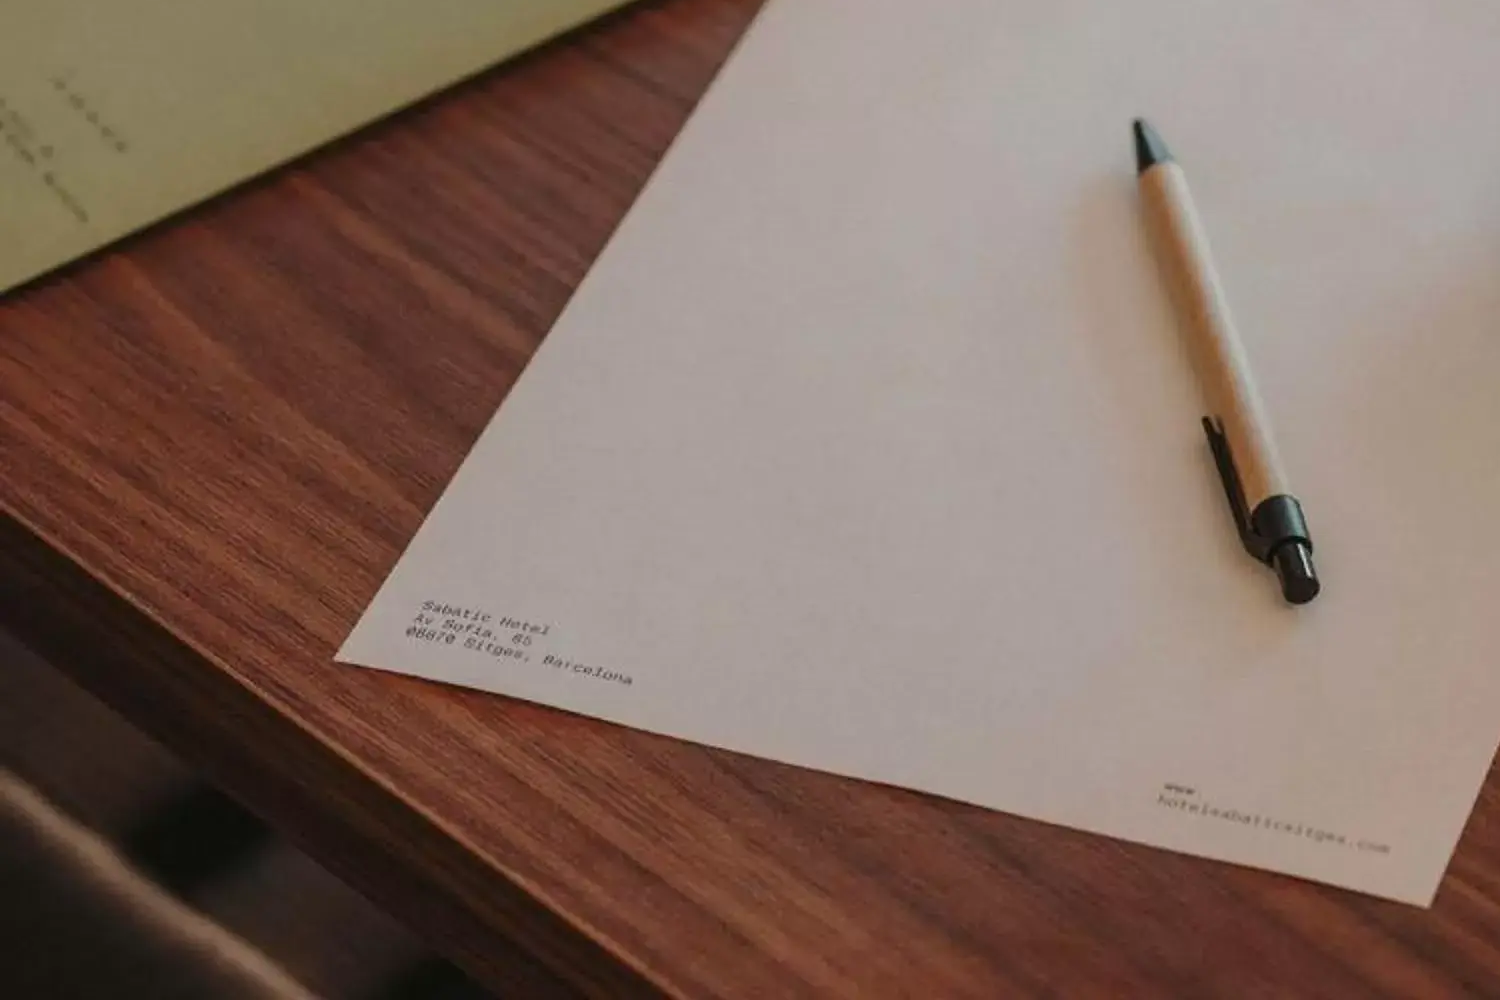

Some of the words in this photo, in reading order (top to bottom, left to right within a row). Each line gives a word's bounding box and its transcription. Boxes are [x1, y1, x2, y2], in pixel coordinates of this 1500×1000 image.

[414, 612, 433, 626] Av
[500, 616, 550, 636] Hotel
[406, 626, 456, 645] 08870
[463, 637, 530, 663] Sitges,
[542, 654, 634, 686] Barcelona
